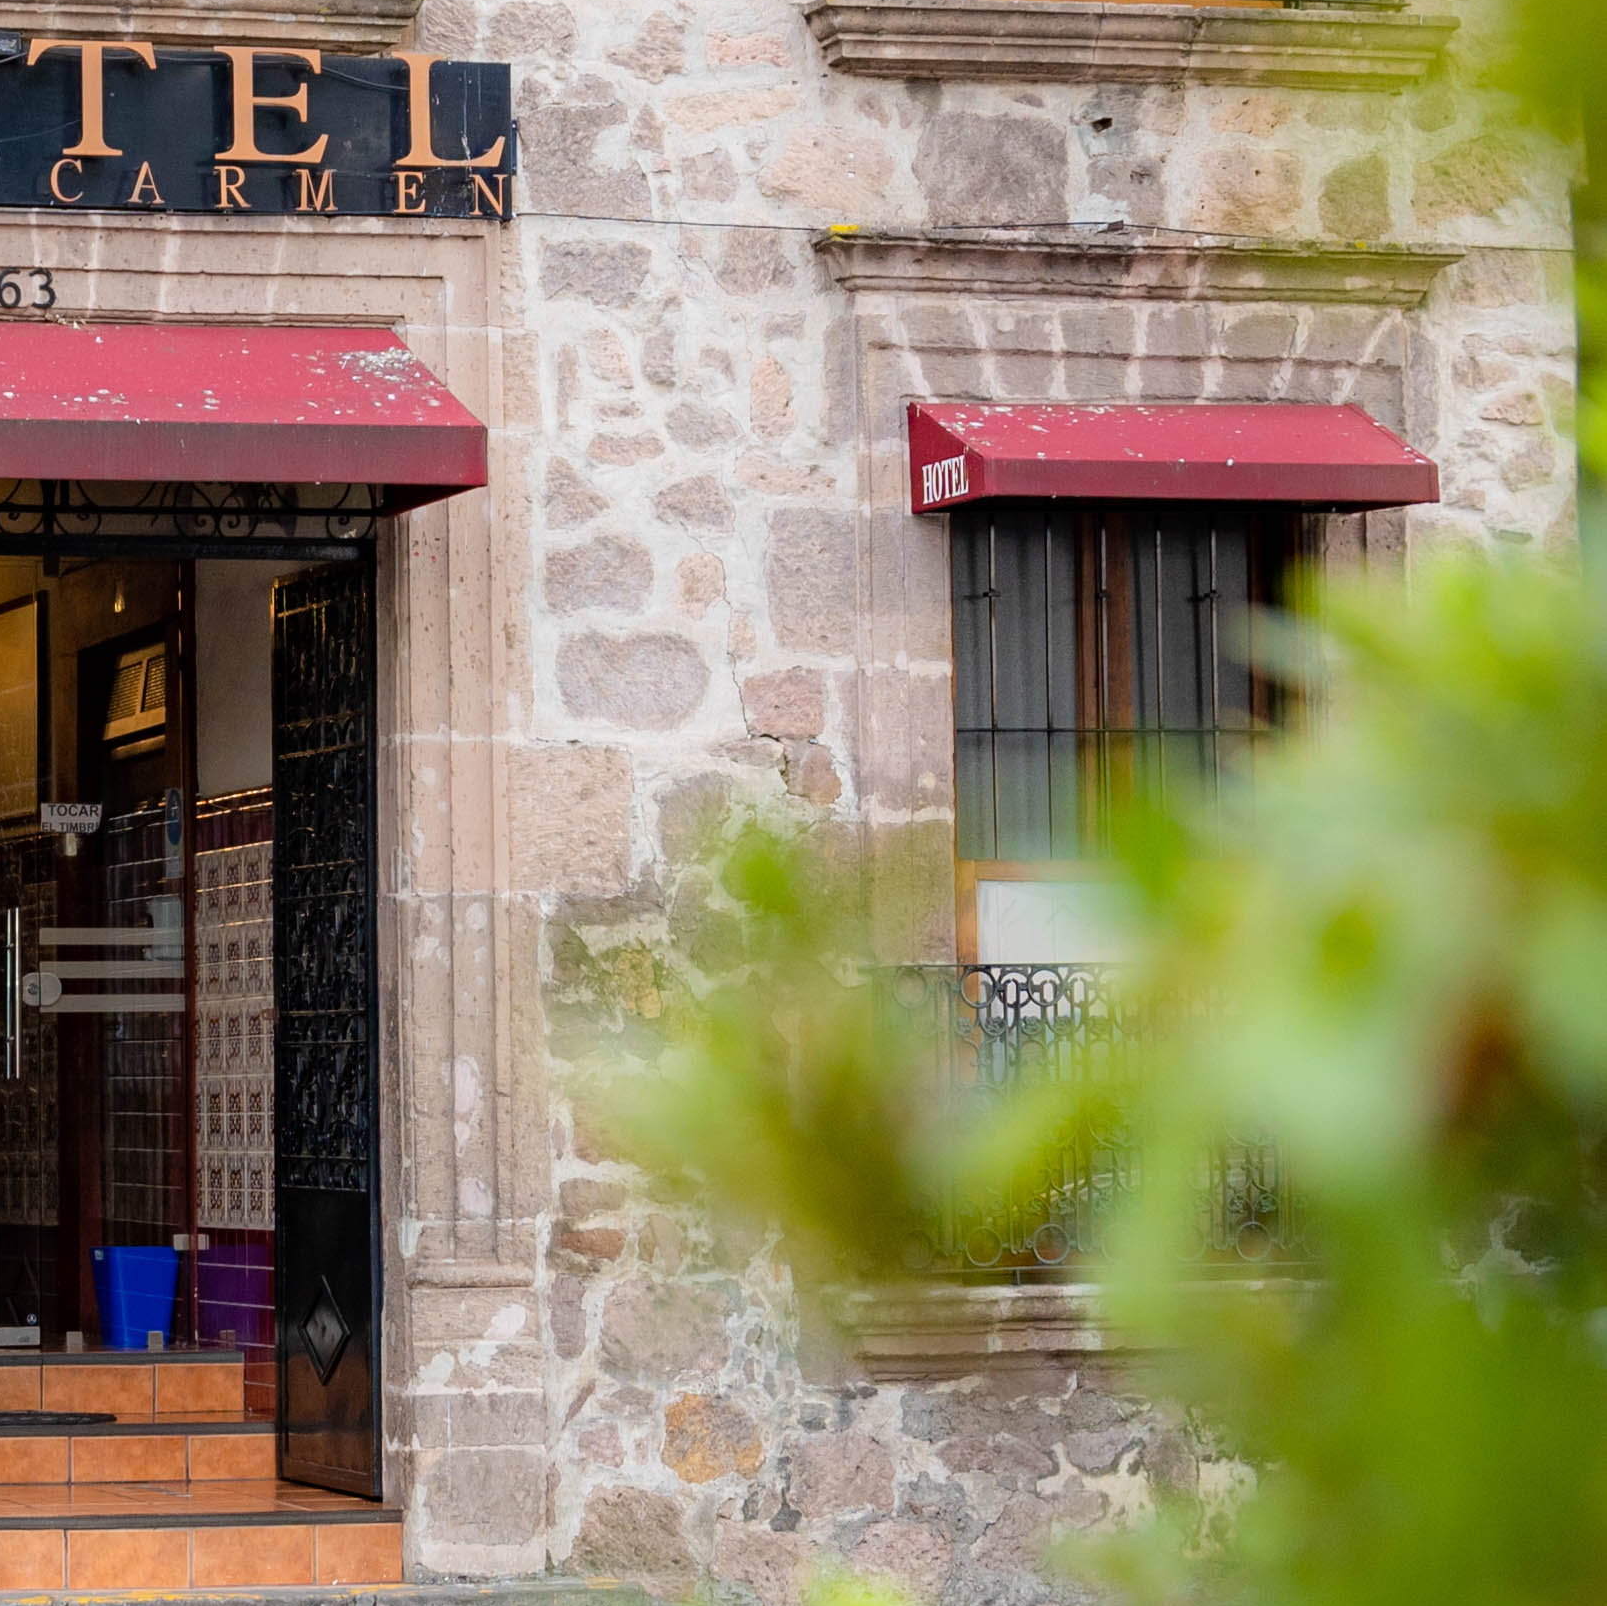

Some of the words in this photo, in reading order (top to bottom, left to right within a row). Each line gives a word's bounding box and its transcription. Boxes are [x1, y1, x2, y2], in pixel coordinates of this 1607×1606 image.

[49, 158, 508, 216] CARMEN
[922, 454, 969, 505] HOTEL
[48, 804, 99, 817] TOCAR
